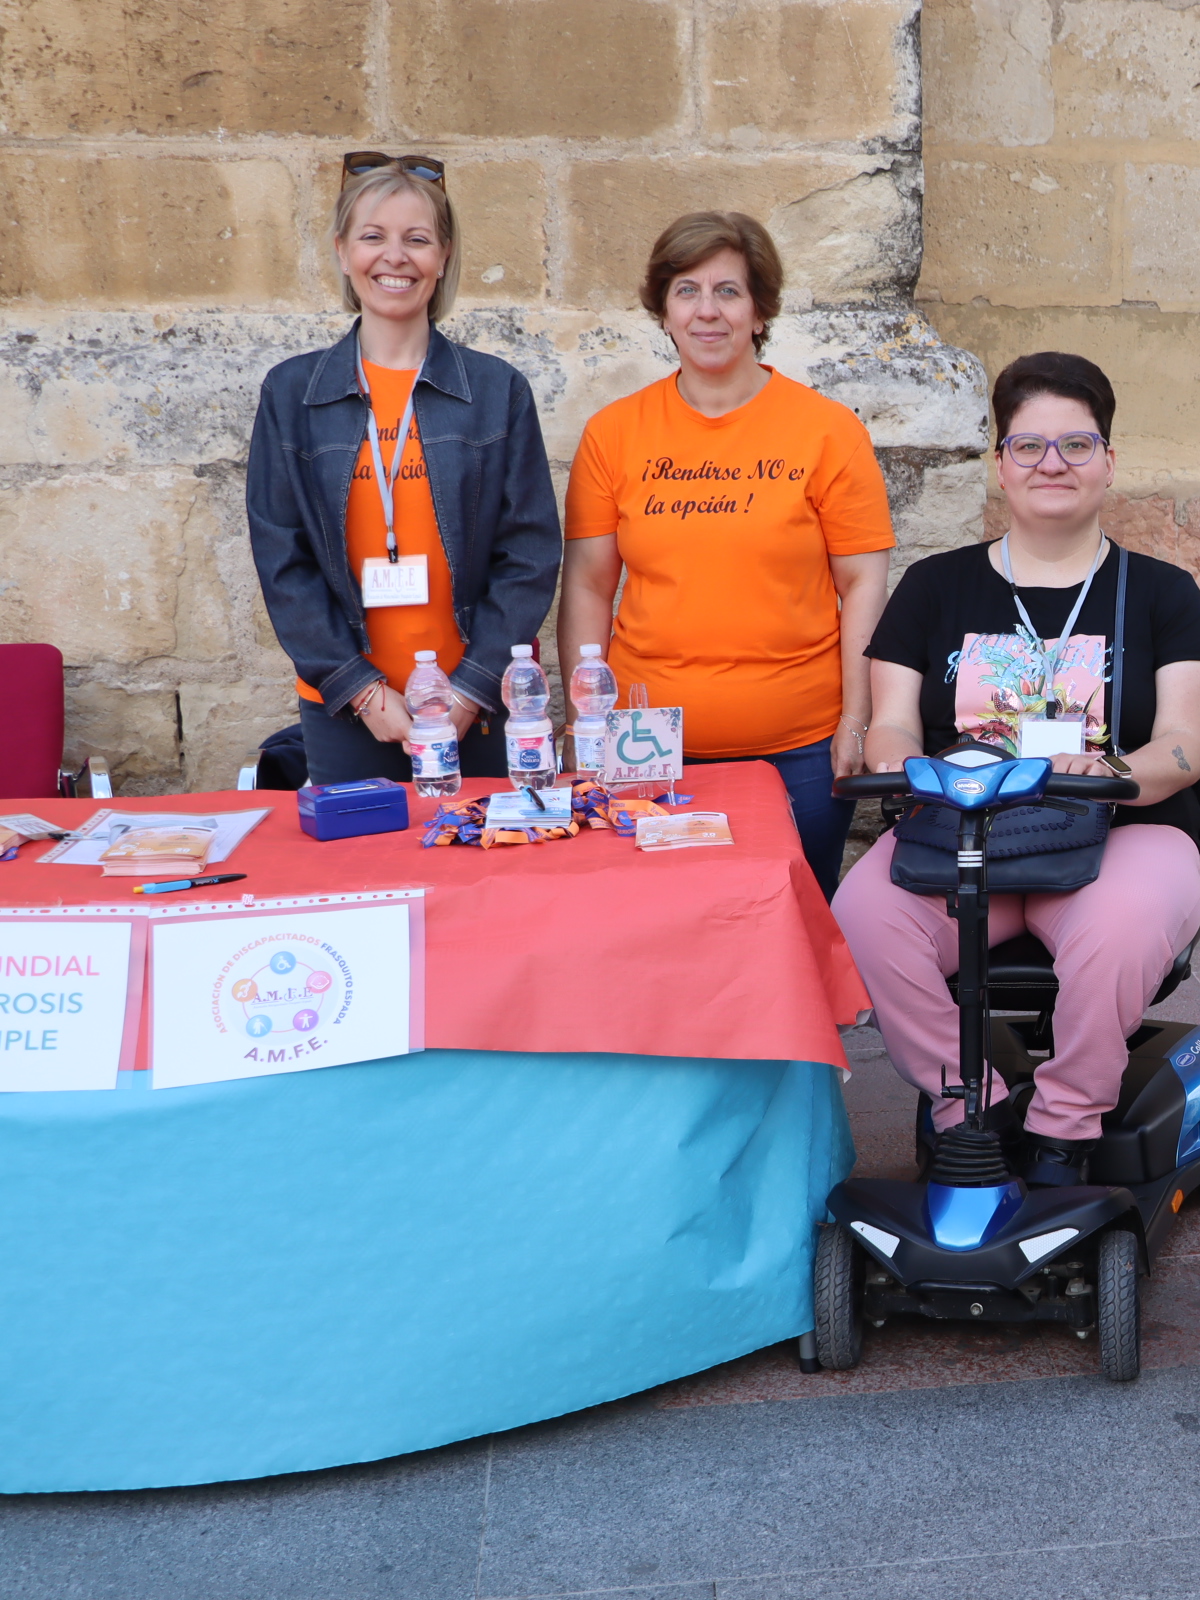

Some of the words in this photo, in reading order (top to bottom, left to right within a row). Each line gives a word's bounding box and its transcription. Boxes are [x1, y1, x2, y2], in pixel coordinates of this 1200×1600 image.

[747, 459, 786, 480] NO
[788, 467, 805, 481] es
[644, 494, 665, 516] la
[671, 494, 738, 520] opción
[0, 955, 100, 977] NDIAL
[232, 933, 321, 961] DISCAPACITADOS
[333, 989, 353, 1025] ESPADA
